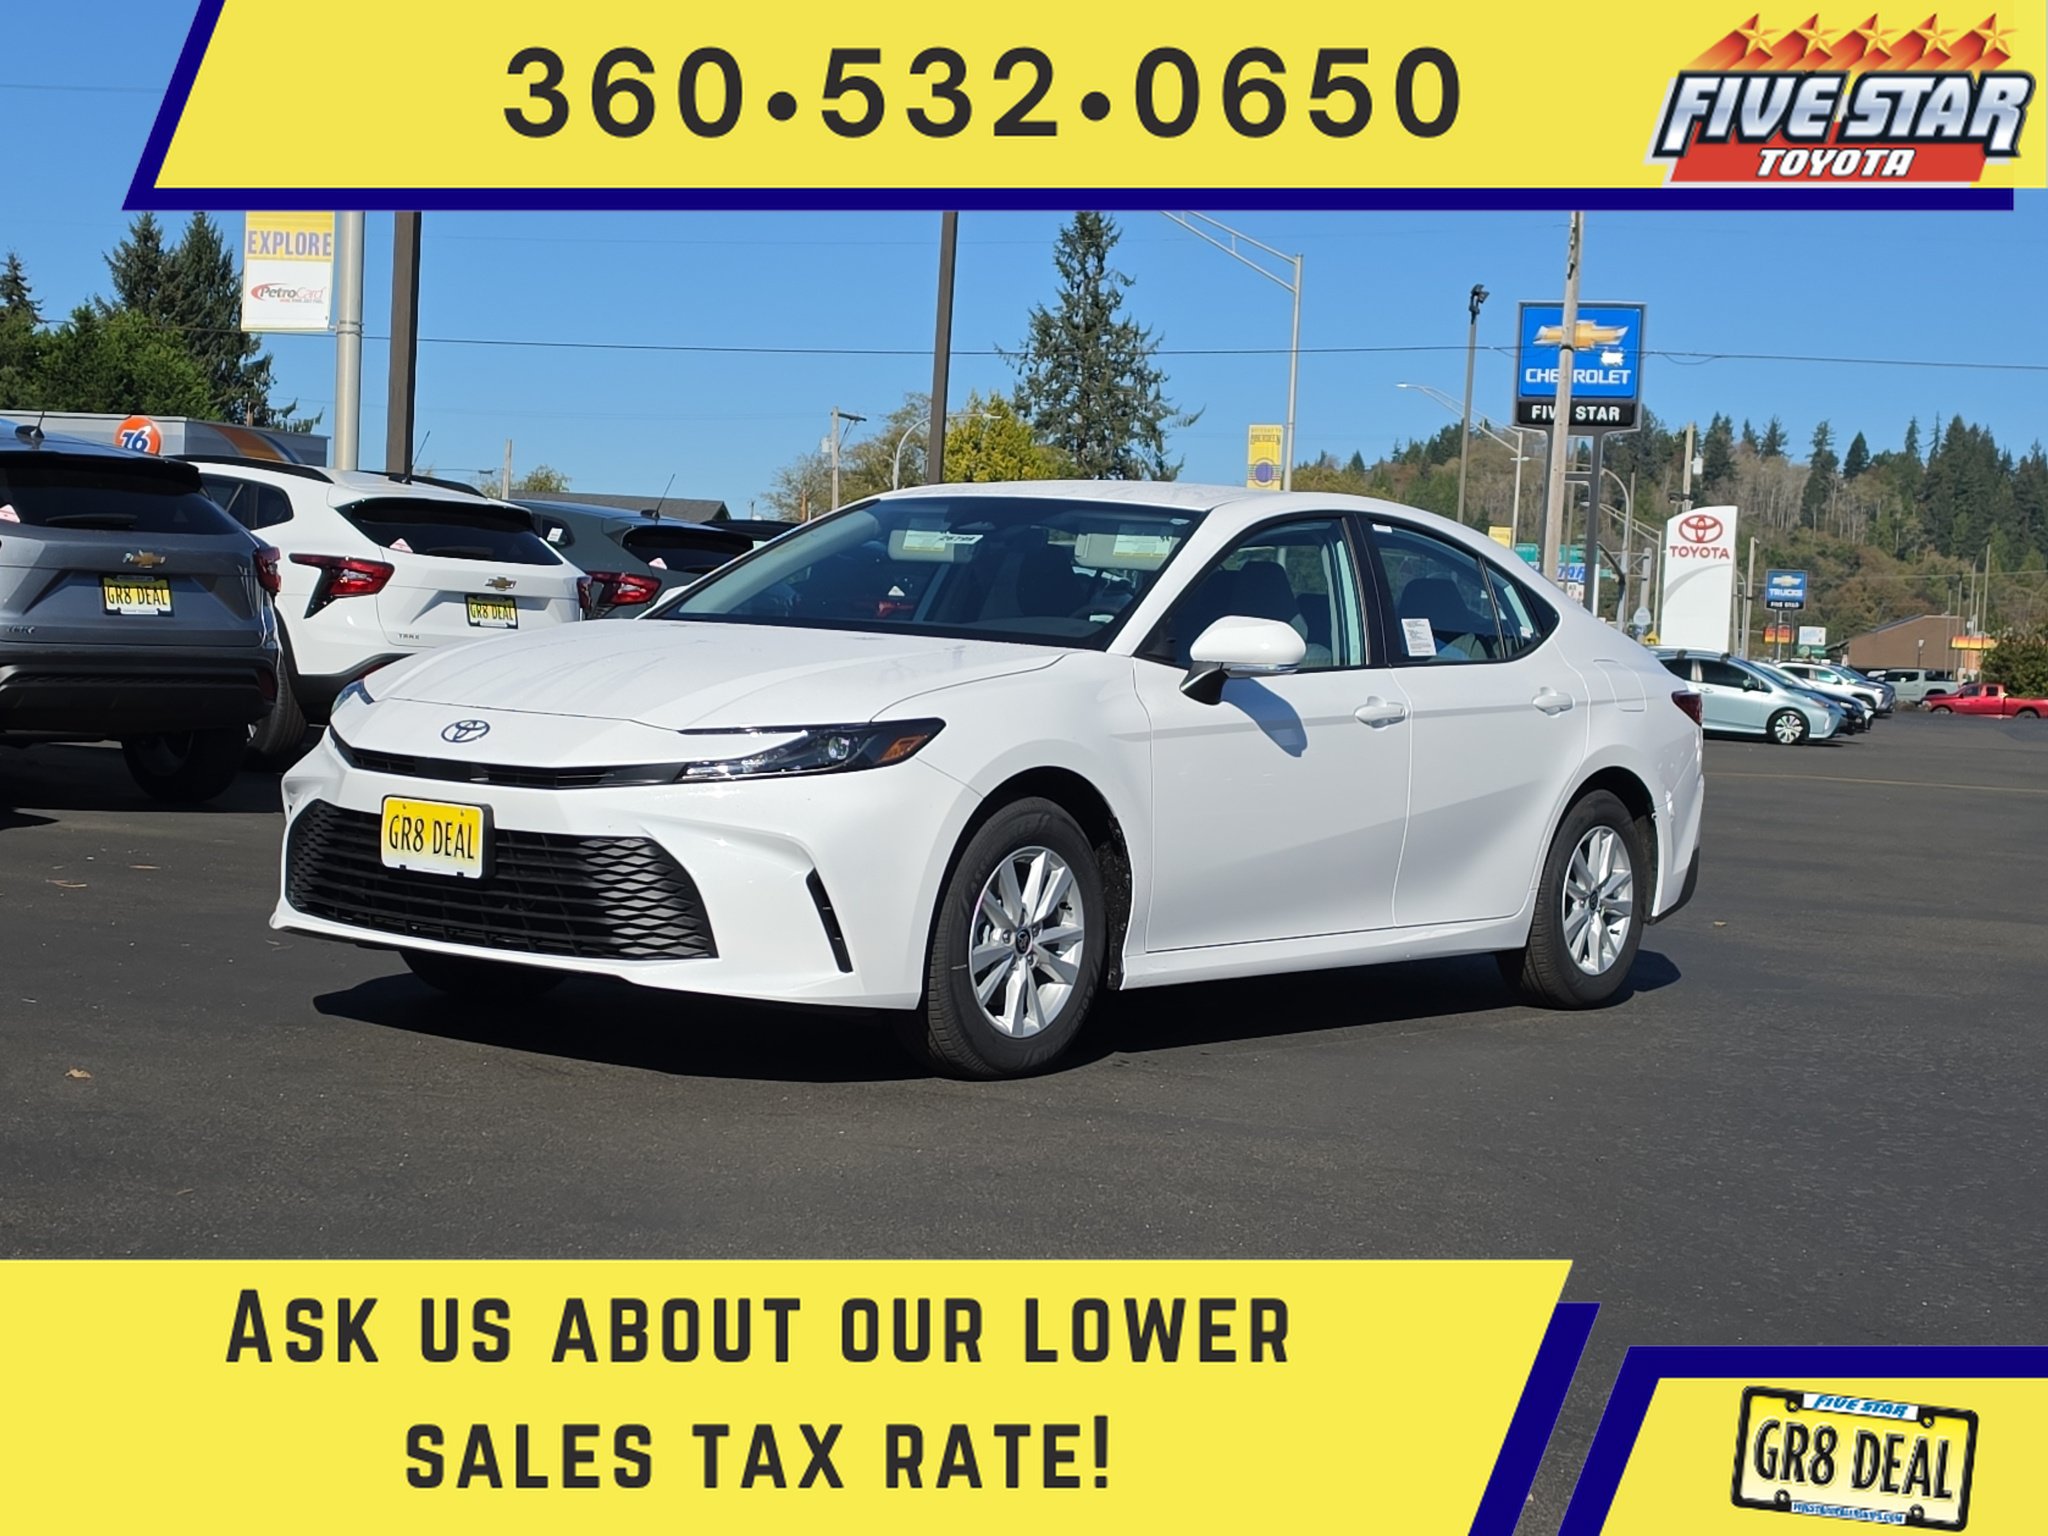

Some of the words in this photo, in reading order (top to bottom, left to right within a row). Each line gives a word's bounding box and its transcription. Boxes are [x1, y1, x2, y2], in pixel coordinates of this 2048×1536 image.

[247, 230, 332, 256] EXPLORE
[1525, 368, 1632, 385] CHEROLET
[1531, 404, 1557, 420] FIV
[1575, 405, 1620, 421] STAR
[120, 425, 151, 453] 76
[1669, 545, 1730, 559] TOYOTA
[107, 586, 132, 605] GR8
[137, 586, 167, 606] DEAL
[470, 602, 489, 619] GR8
[492, 604, 514, 620] DEAL
[388, 814, 425, 853] GR8
[432, 820, 475, 859] DEAL
